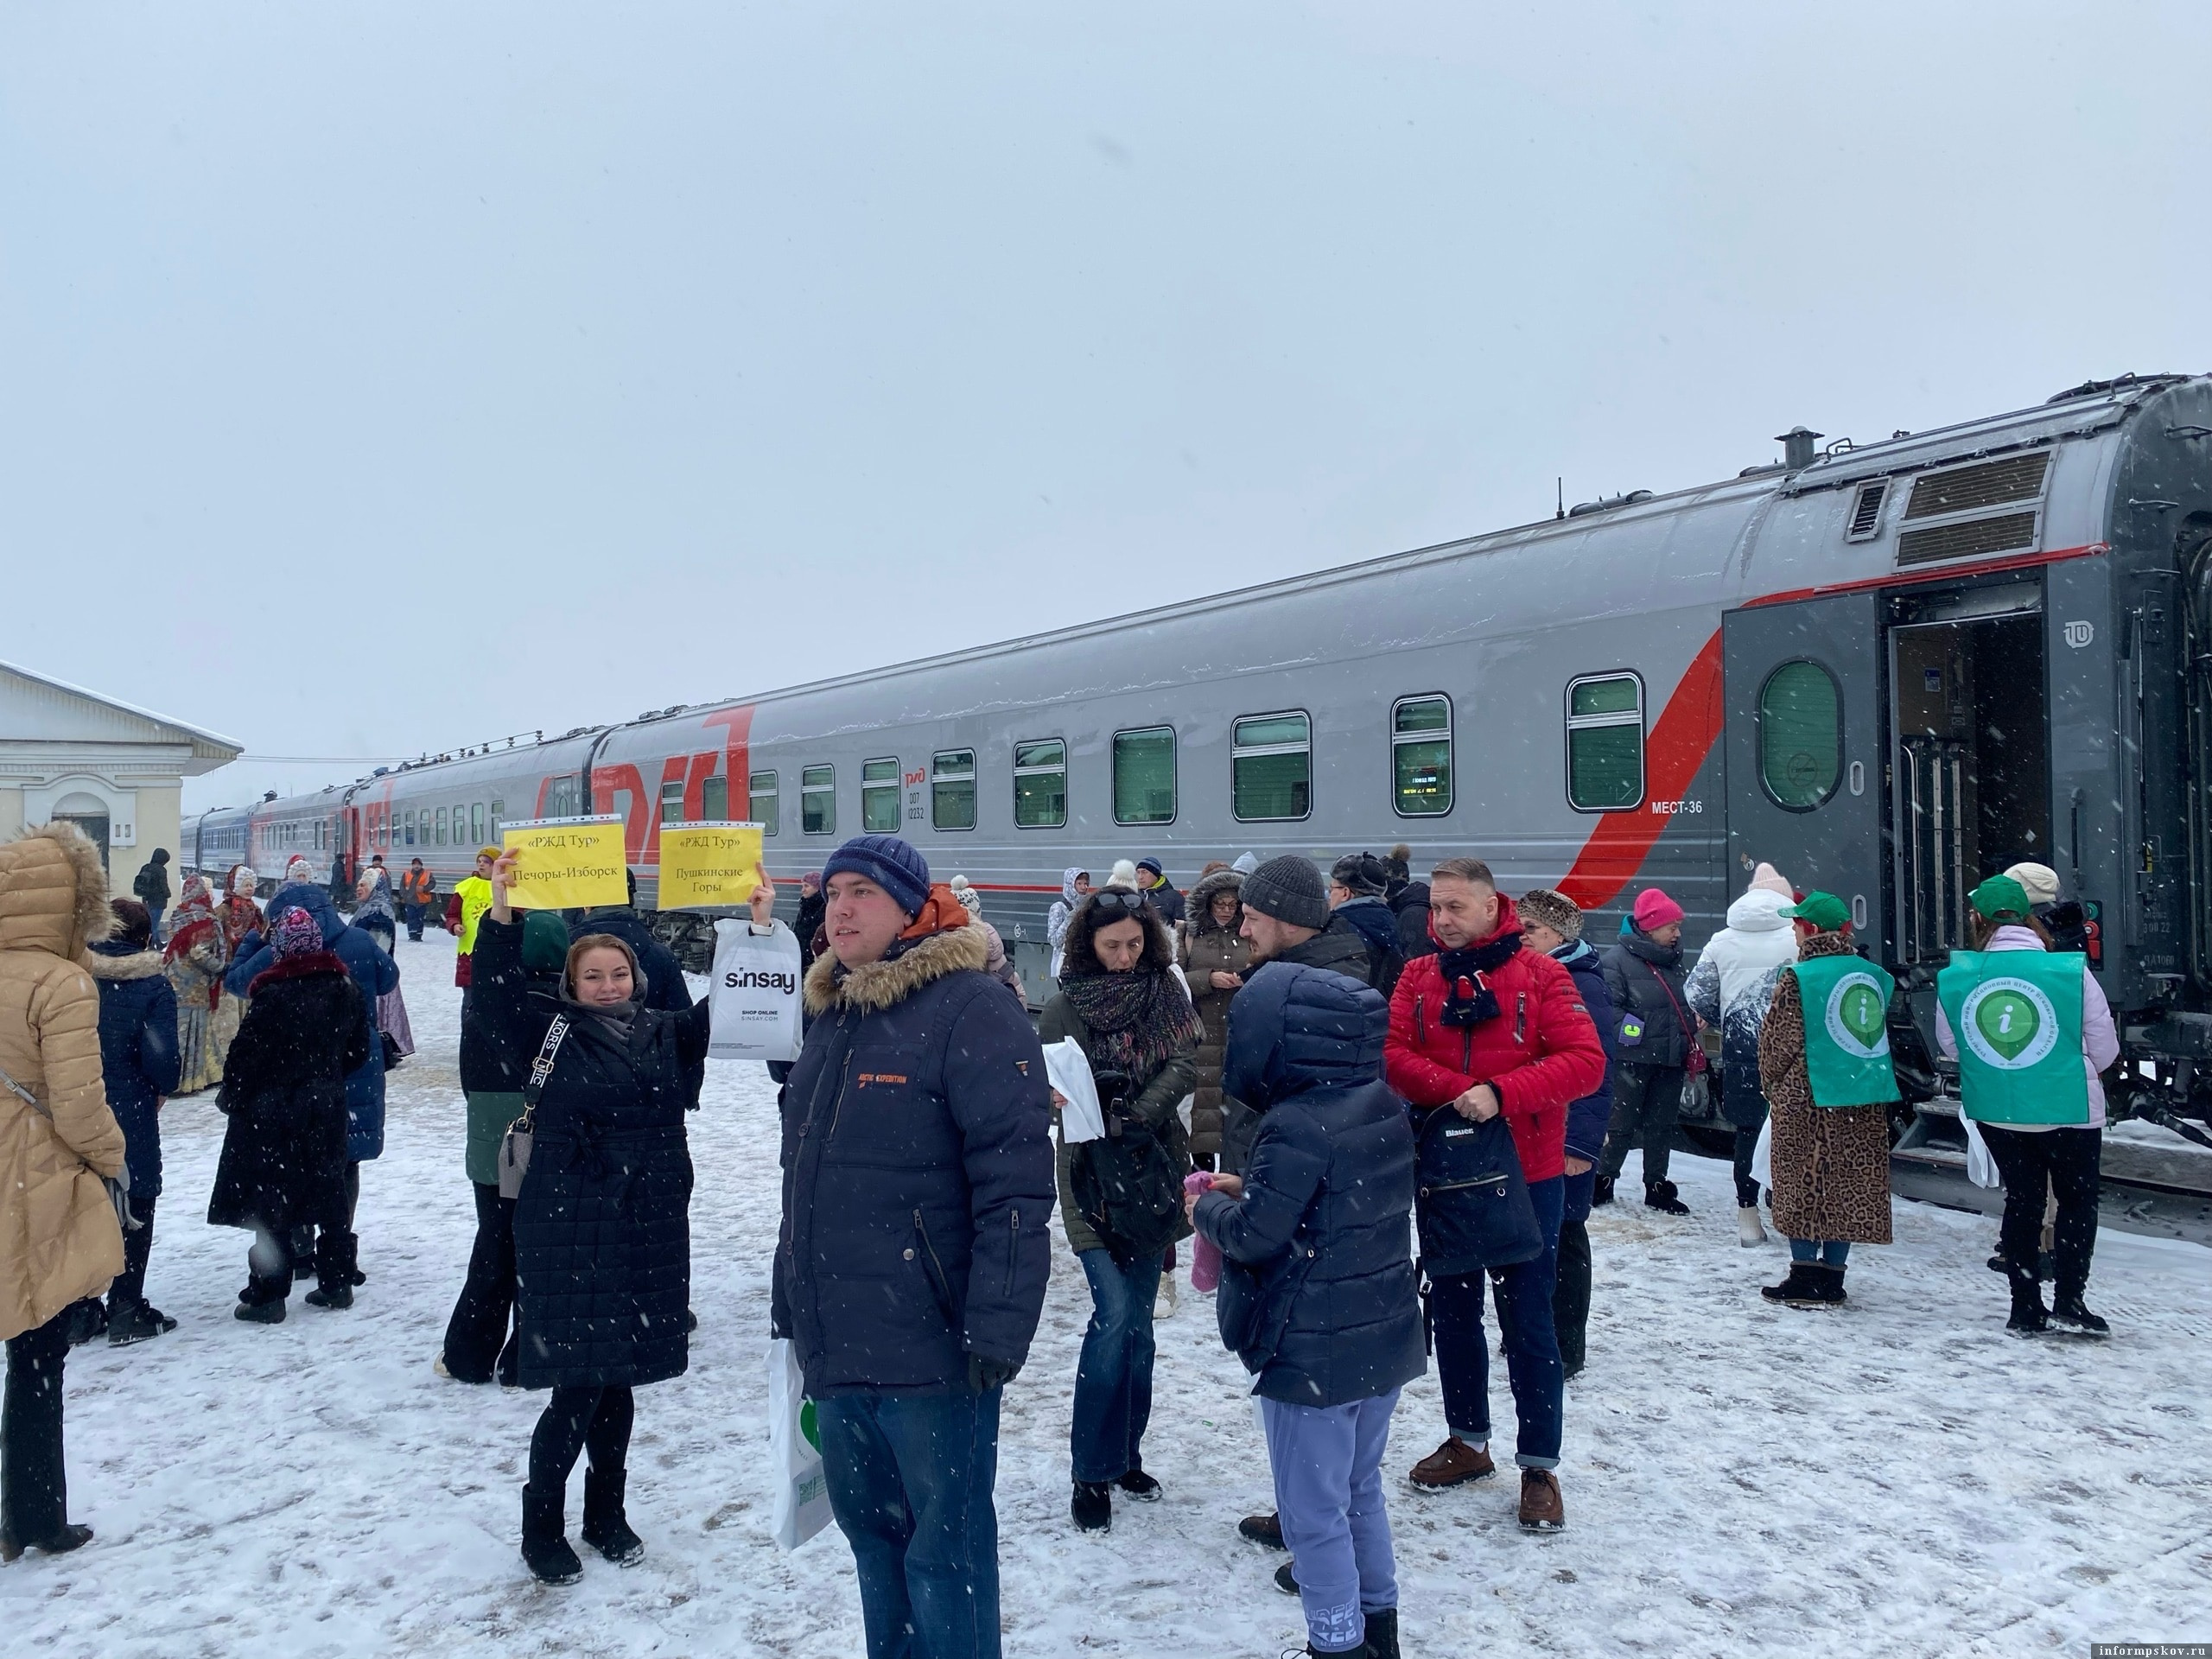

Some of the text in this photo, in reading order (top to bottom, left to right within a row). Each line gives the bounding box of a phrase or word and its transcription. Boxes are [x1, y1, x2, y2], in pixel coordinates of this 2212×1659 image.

[909, 792, 920, 804] 007
[907, 807, 925, 819] 12232
[1651, 800, 1702, 814] МЕСТ-36
[528, 835, 600, 849] «РЖД Тур»
[679, 836, 741, 849] «РЖД Тур»
[512, 866, 618, 882] Печоры-Изборск
[676, 868, 743, 881] Пушкинские
[693, 881, 721, 893] Горы
[725, 967, 795, 995] sinsay
[546, 1021, 565, 1050] KORS
